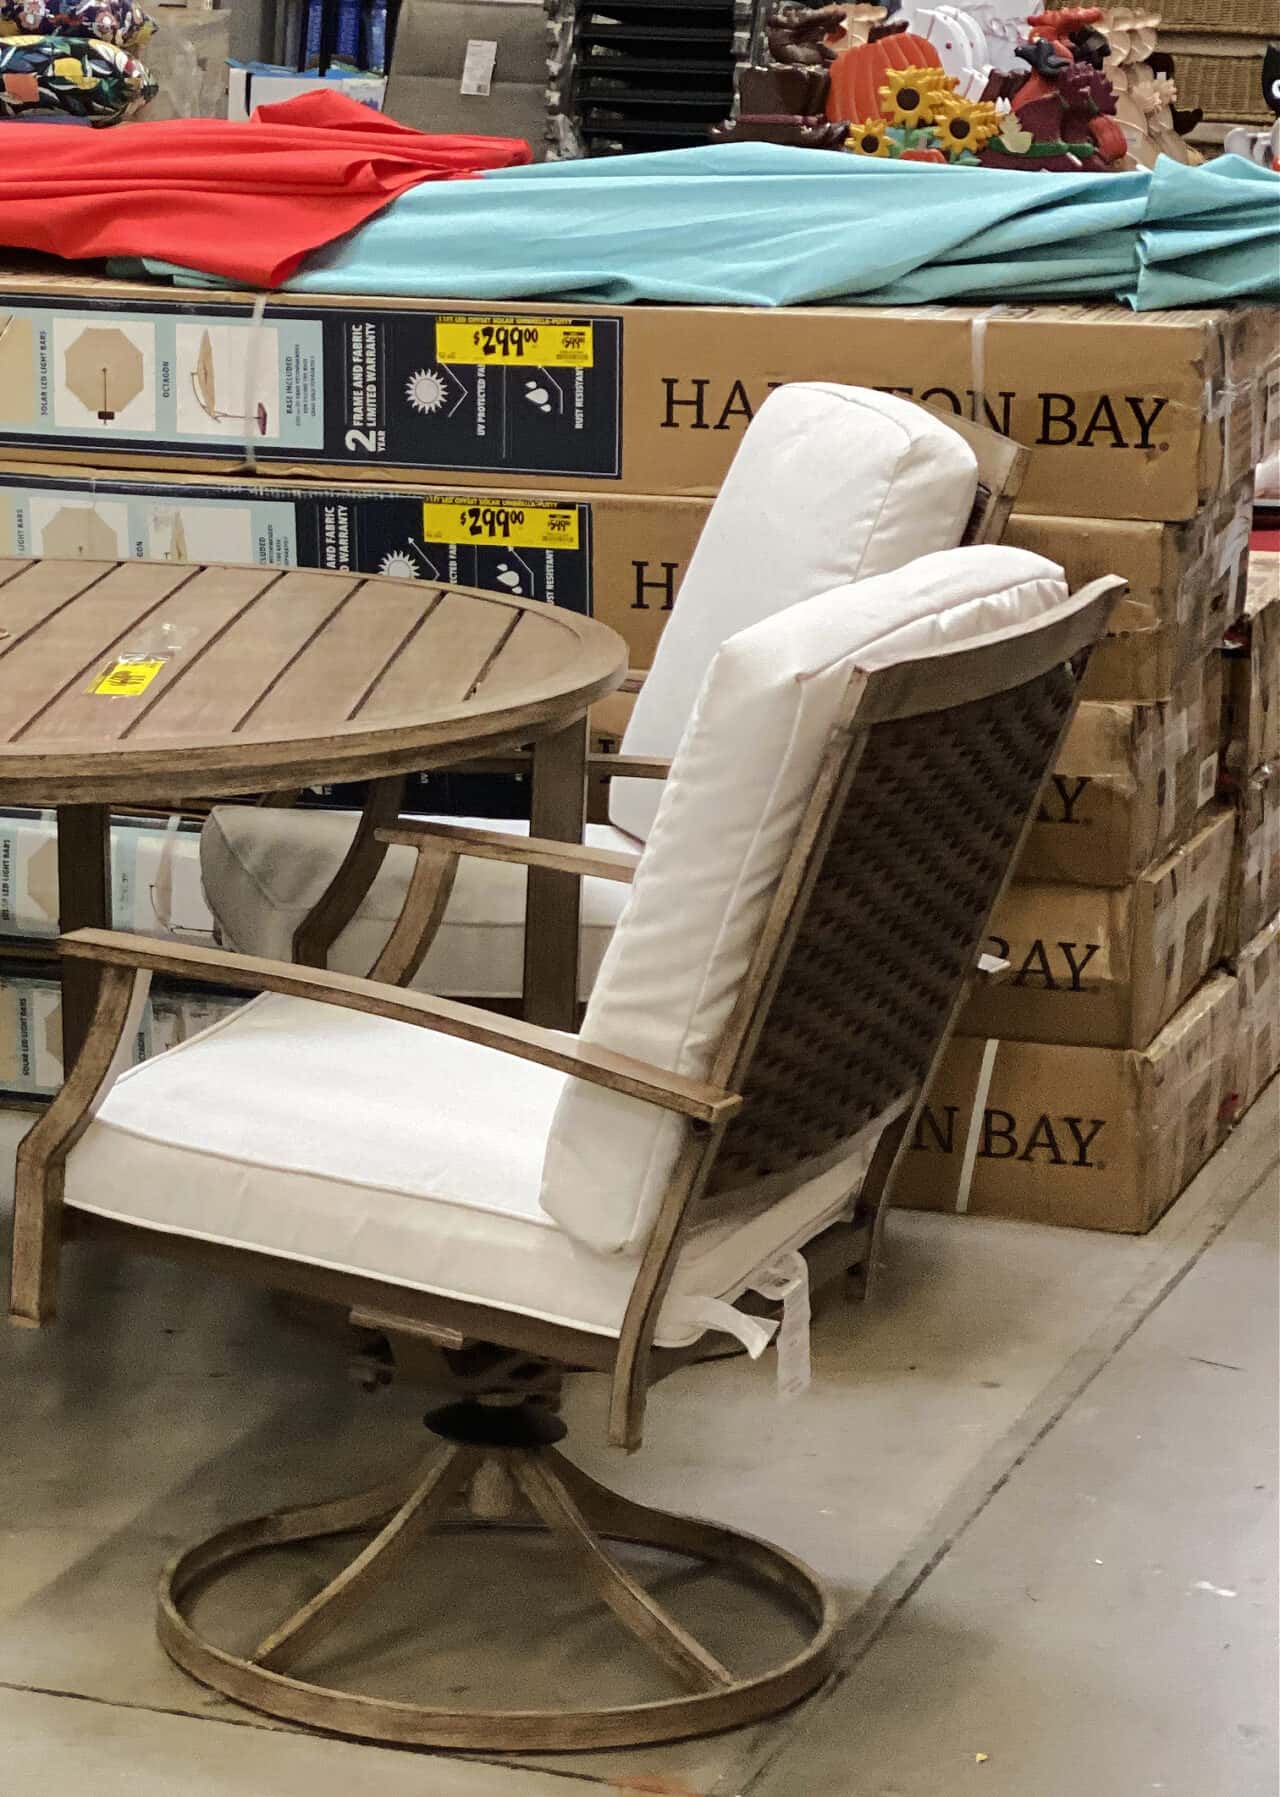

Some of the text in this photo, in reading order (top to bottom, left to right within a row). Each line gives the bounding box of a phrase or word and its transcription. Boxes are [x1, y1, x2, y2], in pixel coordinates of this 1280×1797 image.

[162, 361, 170, 398] OCTAGON
[285, 356, 293, 394] INCLUDED
[351, 324, 364, 426] FRAME AND FABRIC
[364, 322, 377, 426] LIMITED WARRANTY
[40, 391, 48, 415] SOLAR
[476, 378, 486, 422] PROTECTED
[574, 409, 584, 429] RUST
[661, 378, 1169, 449] HAON BAY
[345, 430, 376, 452] 2
[377, 431, 386, 452] YEAR
[477, 424, 486, 436] UV
[325, 506, 336, 568] AND FABRIC
[338, 505, 349, 562] WARRANTY
[546, 550, 554, 589] RESISTANT
[2, 860, 10, 881] LIGHT
[137, 1032, 146, 1061] CTAGON
[977, 1110, 1106, 1168] BAY
